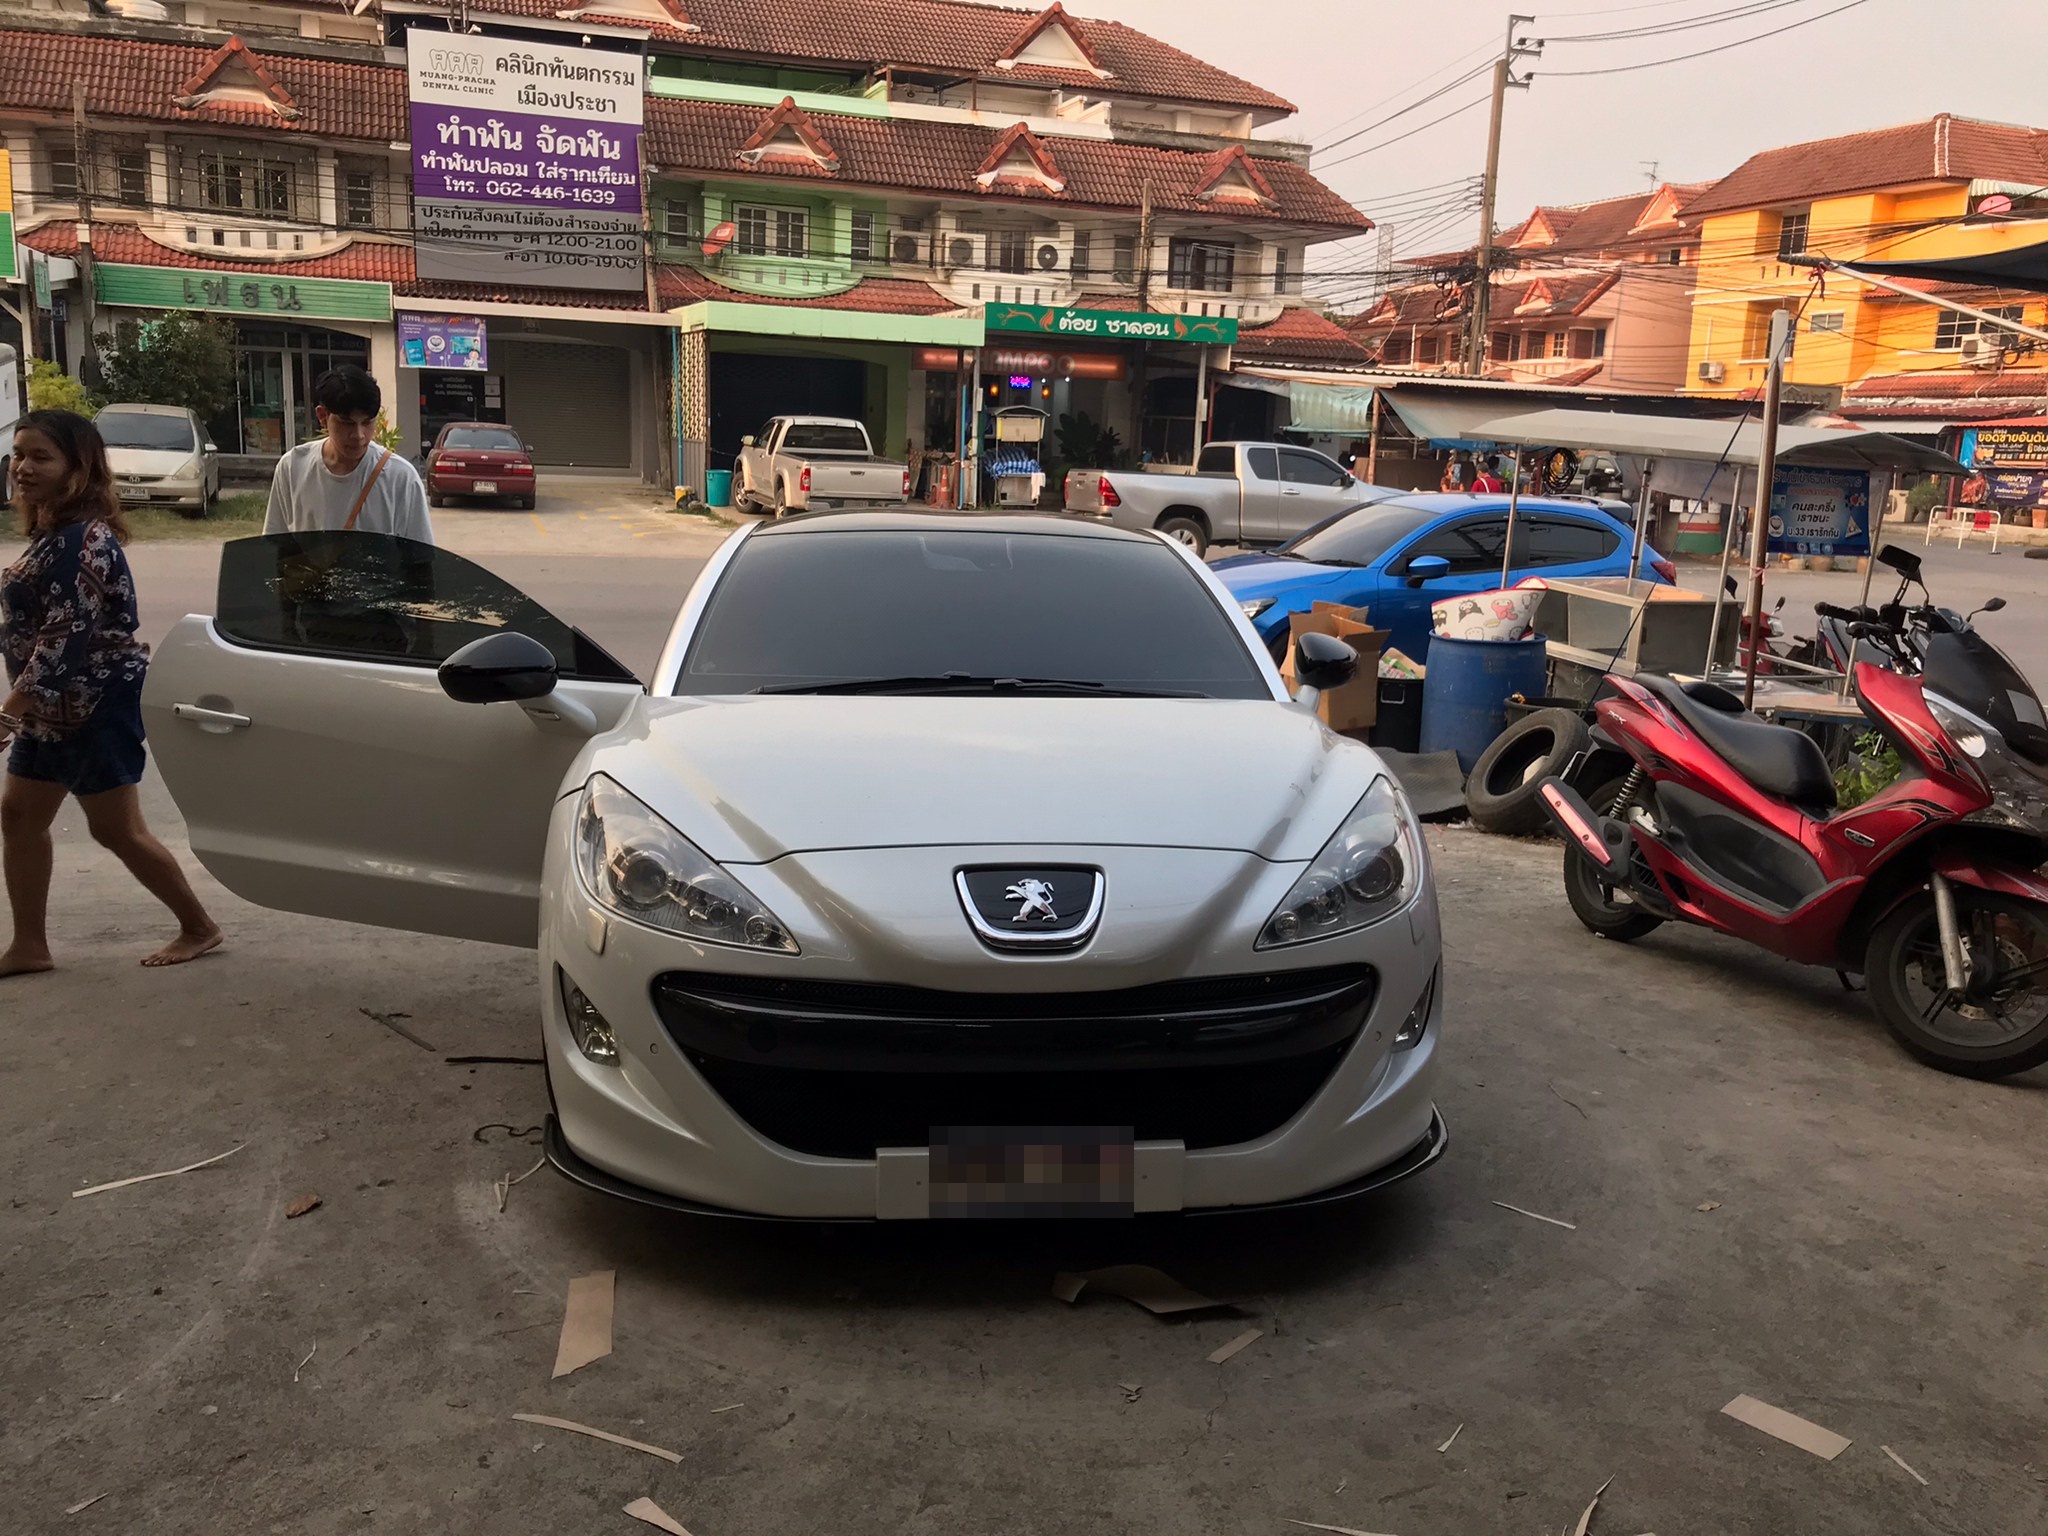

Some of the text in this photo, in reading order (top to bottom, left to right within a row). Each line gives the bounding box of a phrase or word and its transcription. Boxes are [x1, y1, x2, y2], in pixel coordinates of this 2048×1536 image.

[419, 70, 497, 86] MUANG-PRACHA
[495, 52, 635, 86] คลินิกทันตกรรม
[422, 81, 494, 95] DENTAL CLINIC
[517, 83, 617, 113] เมืองประชา
[436, 115, 620, 160] ทำฟัน จัดฟัน
[420, 150, 635, 186] ทำฟันปลอม ใส่รากเทียม
[443, 174, 616, 204] โทร. 062-446-1639
[423, 221, 498, 242] เปิดบริการ
[546, 233, 637, 251] 12.00-21.00
[1058, 311, 1170, 337] ต้อย ซาลอน
[1792, 500, 1836, 513] คนละครึ่ง
[1797, 514, 1830, 523] เราชนะ
